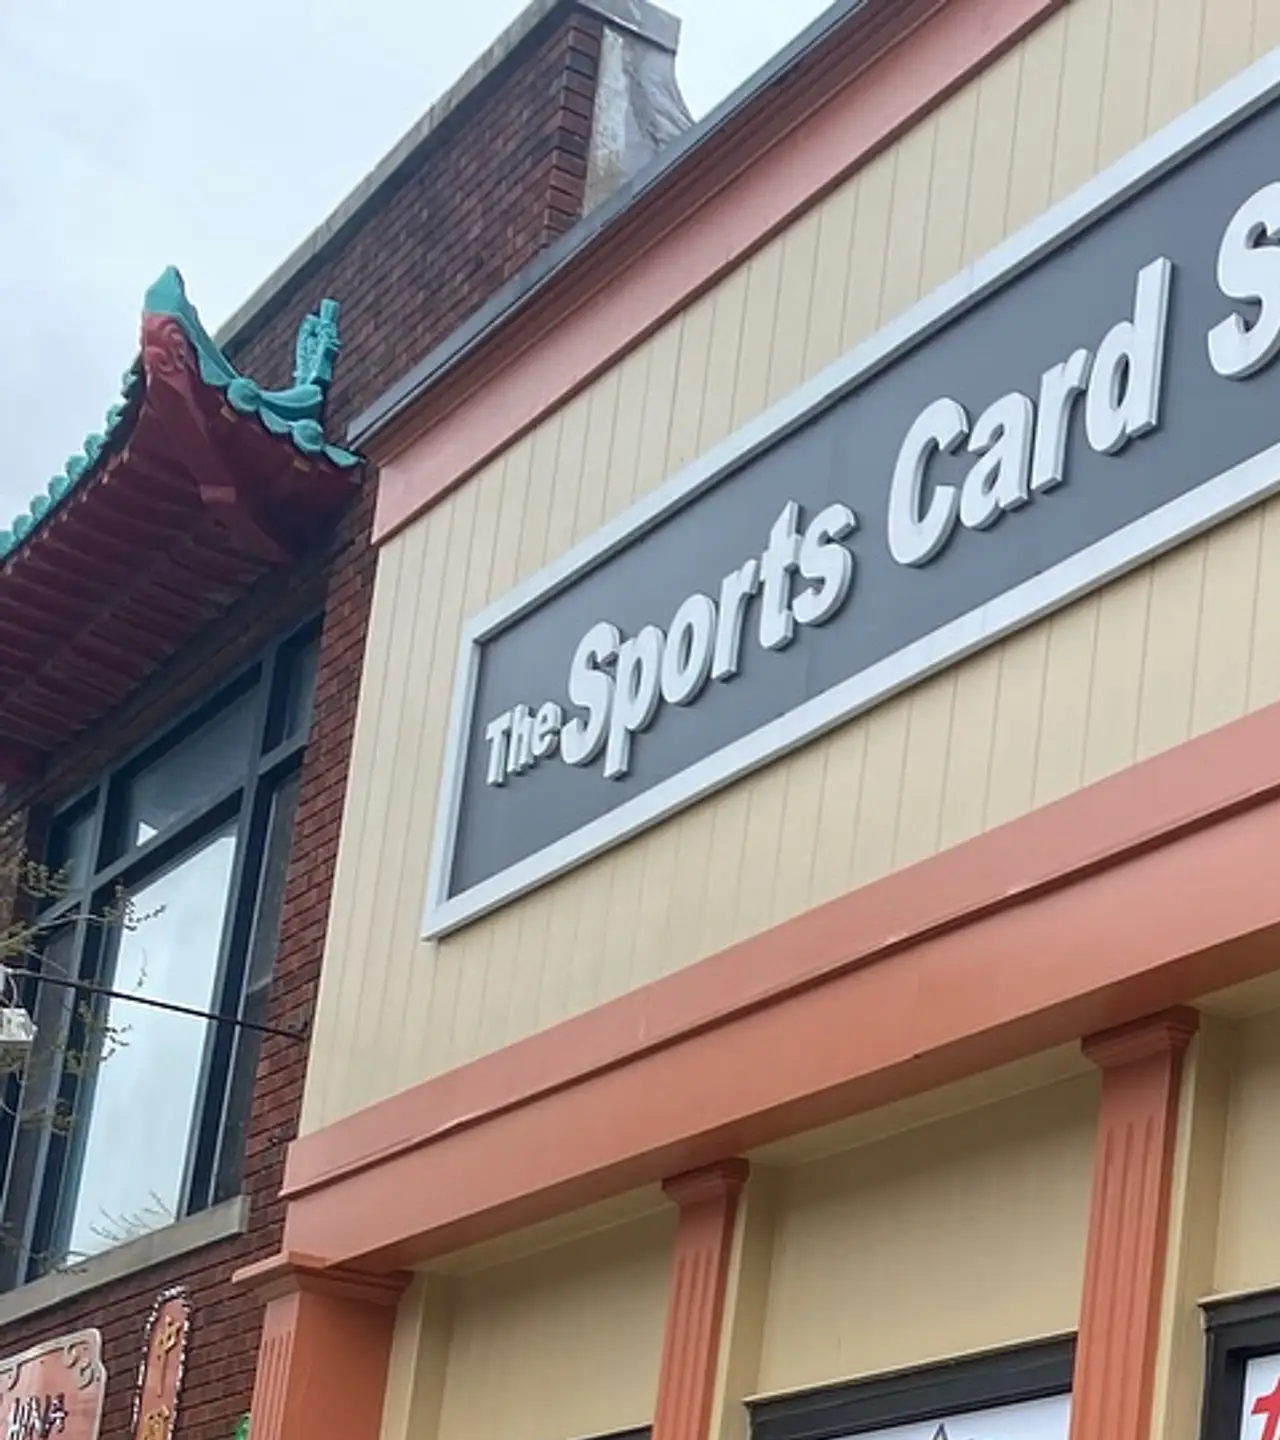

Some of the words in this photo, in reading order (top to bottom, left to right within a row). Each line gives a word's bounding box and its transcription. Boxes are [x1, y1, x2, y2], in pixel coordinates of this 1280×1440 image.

[486, 700, 562, 786] The
[561, 500, 856, 779] Sports
[887, 256, 1172, 567] Card
